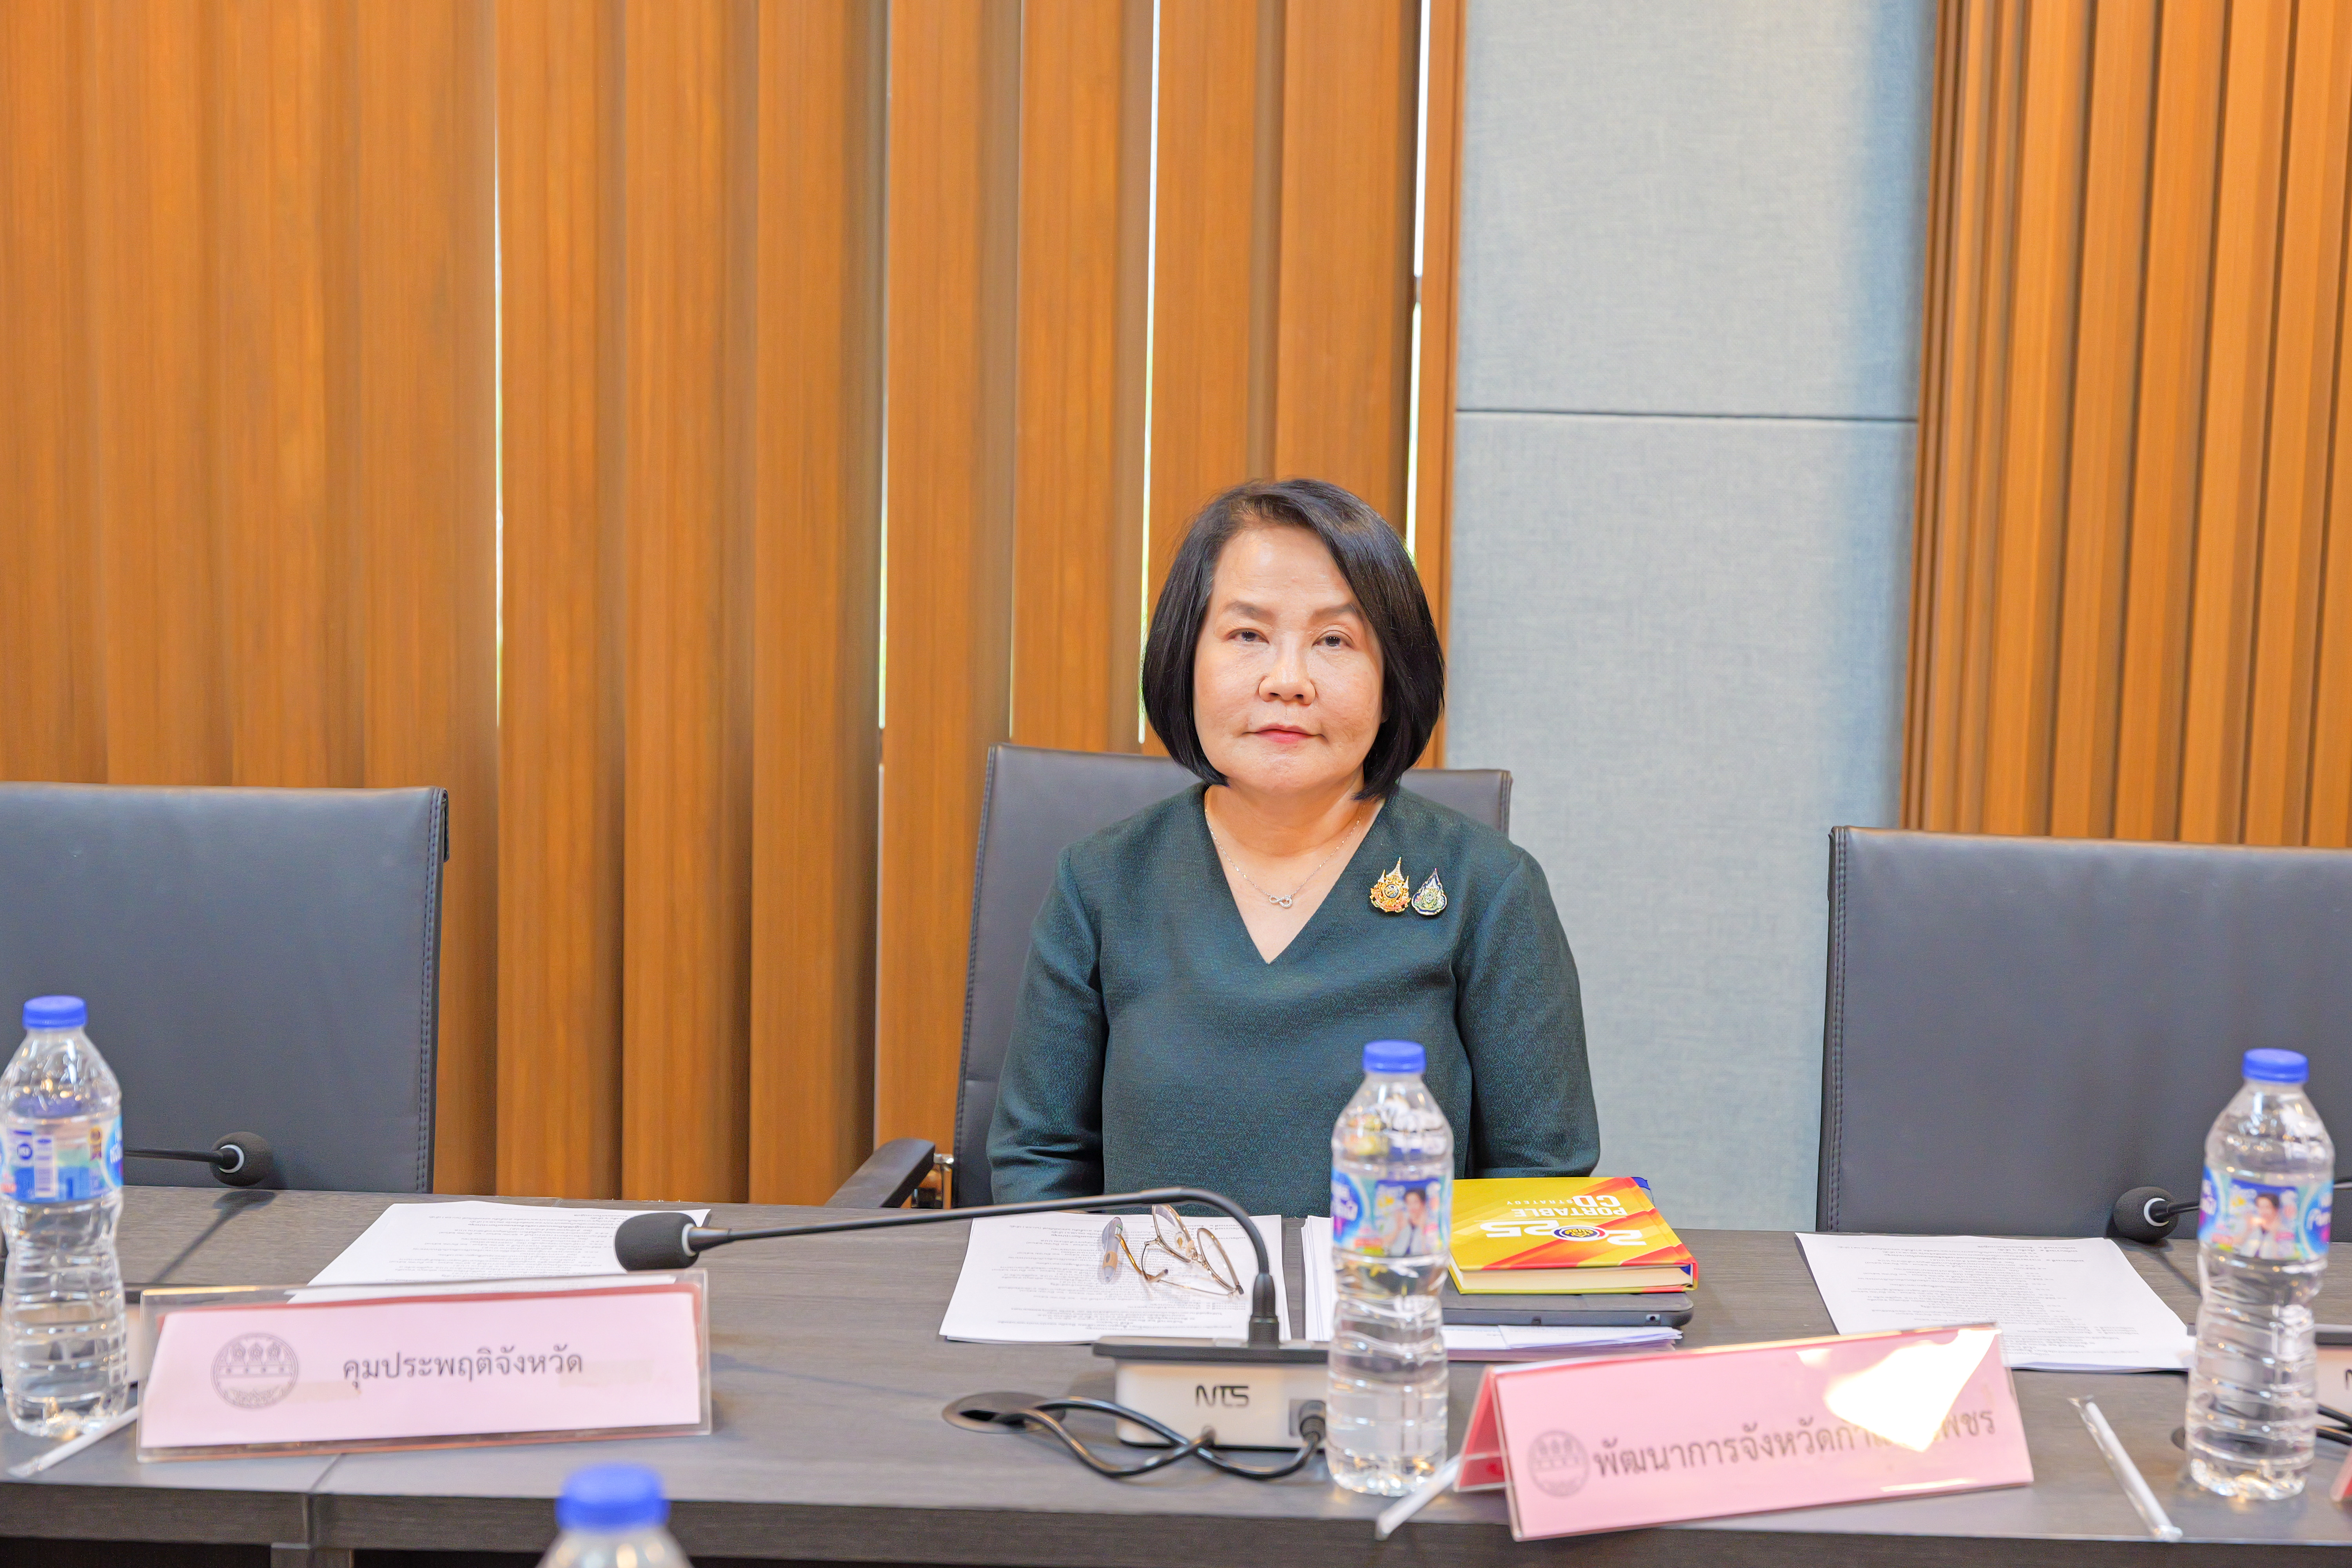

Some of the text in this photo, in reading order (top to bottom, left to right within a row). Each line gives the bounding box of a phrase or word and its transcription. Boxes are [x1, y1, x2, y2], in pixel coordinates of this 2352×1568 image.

[1572, 1195, 1621, 1207] CD
[1511, 1207, 1628, 1217] PORTABLE
[1479, 1220, 1647, 1246] 2025
[343, 1344, 583, 1390] คุมประพฤติจังหวัด
[1196, 1385, 1249, 1406] NTS
